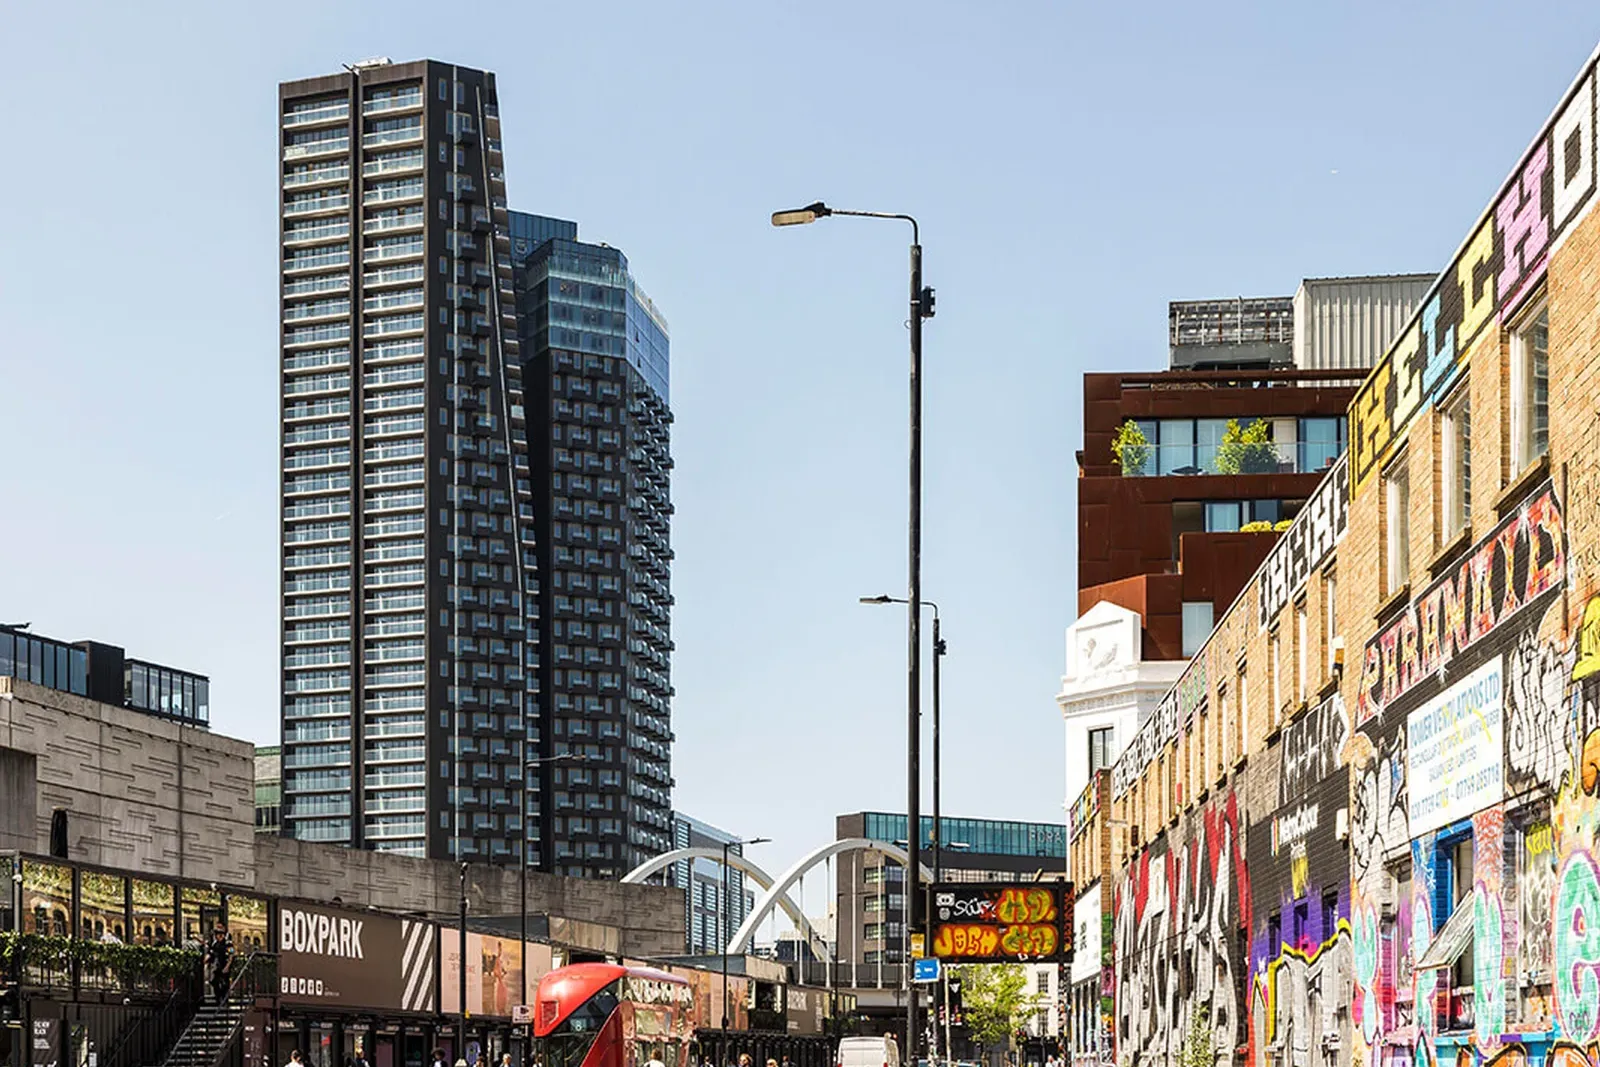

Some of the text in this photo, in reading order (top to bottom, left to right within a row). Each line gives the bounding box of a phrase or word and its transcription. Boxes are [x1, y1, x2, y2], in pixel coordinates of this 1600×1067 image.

[1484, 671, 1500, 704] LTD
[1029, 829, 1064, 844] FORA
[281, 909, 363, 959] BOXPARK
